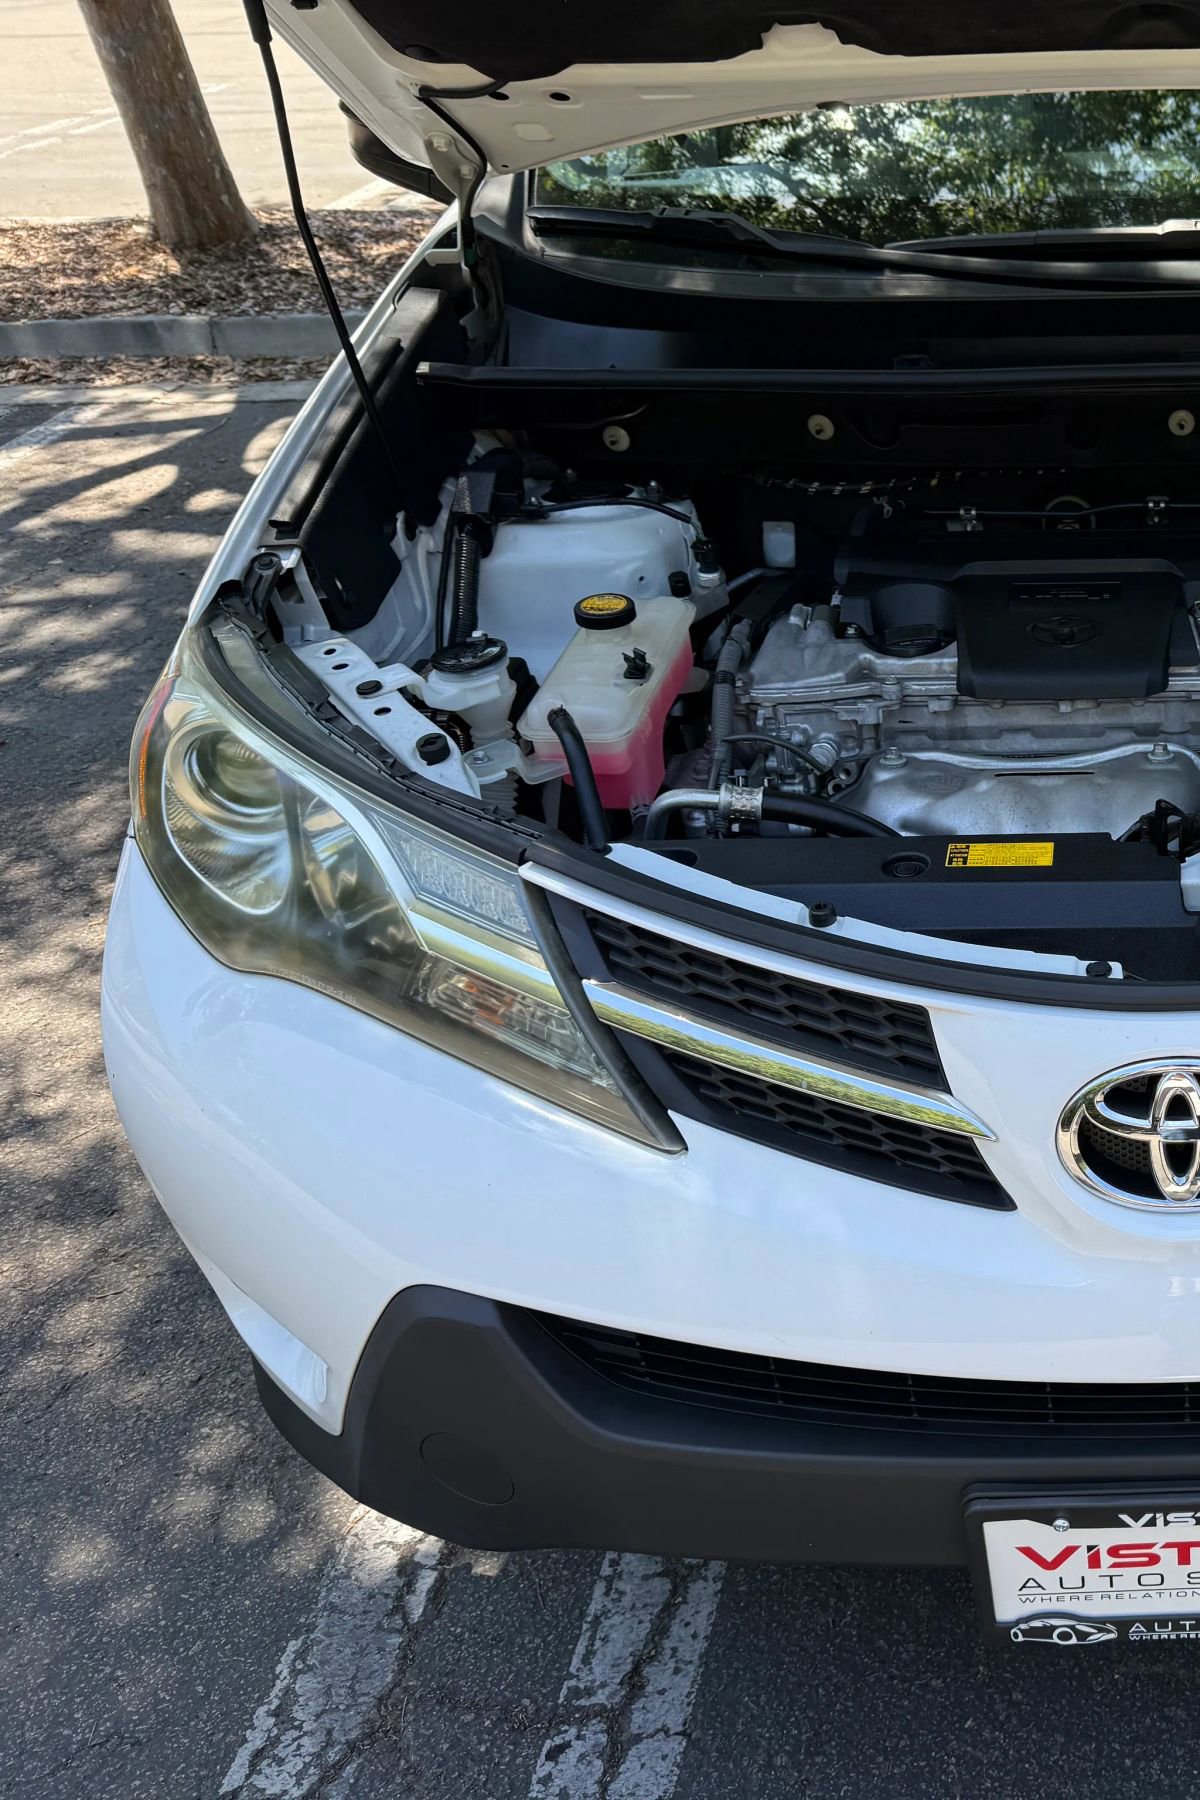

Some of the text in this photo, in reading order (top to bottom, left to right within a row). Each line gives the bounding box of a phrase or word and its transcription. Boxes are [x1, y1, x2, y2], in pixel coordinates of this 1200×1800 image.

[1018, 1573, 1165, 1592] AUTO
[1018, 1594, 1094, 1604] WHERE
[1128, 1633, 1177, 1641] WHERE
